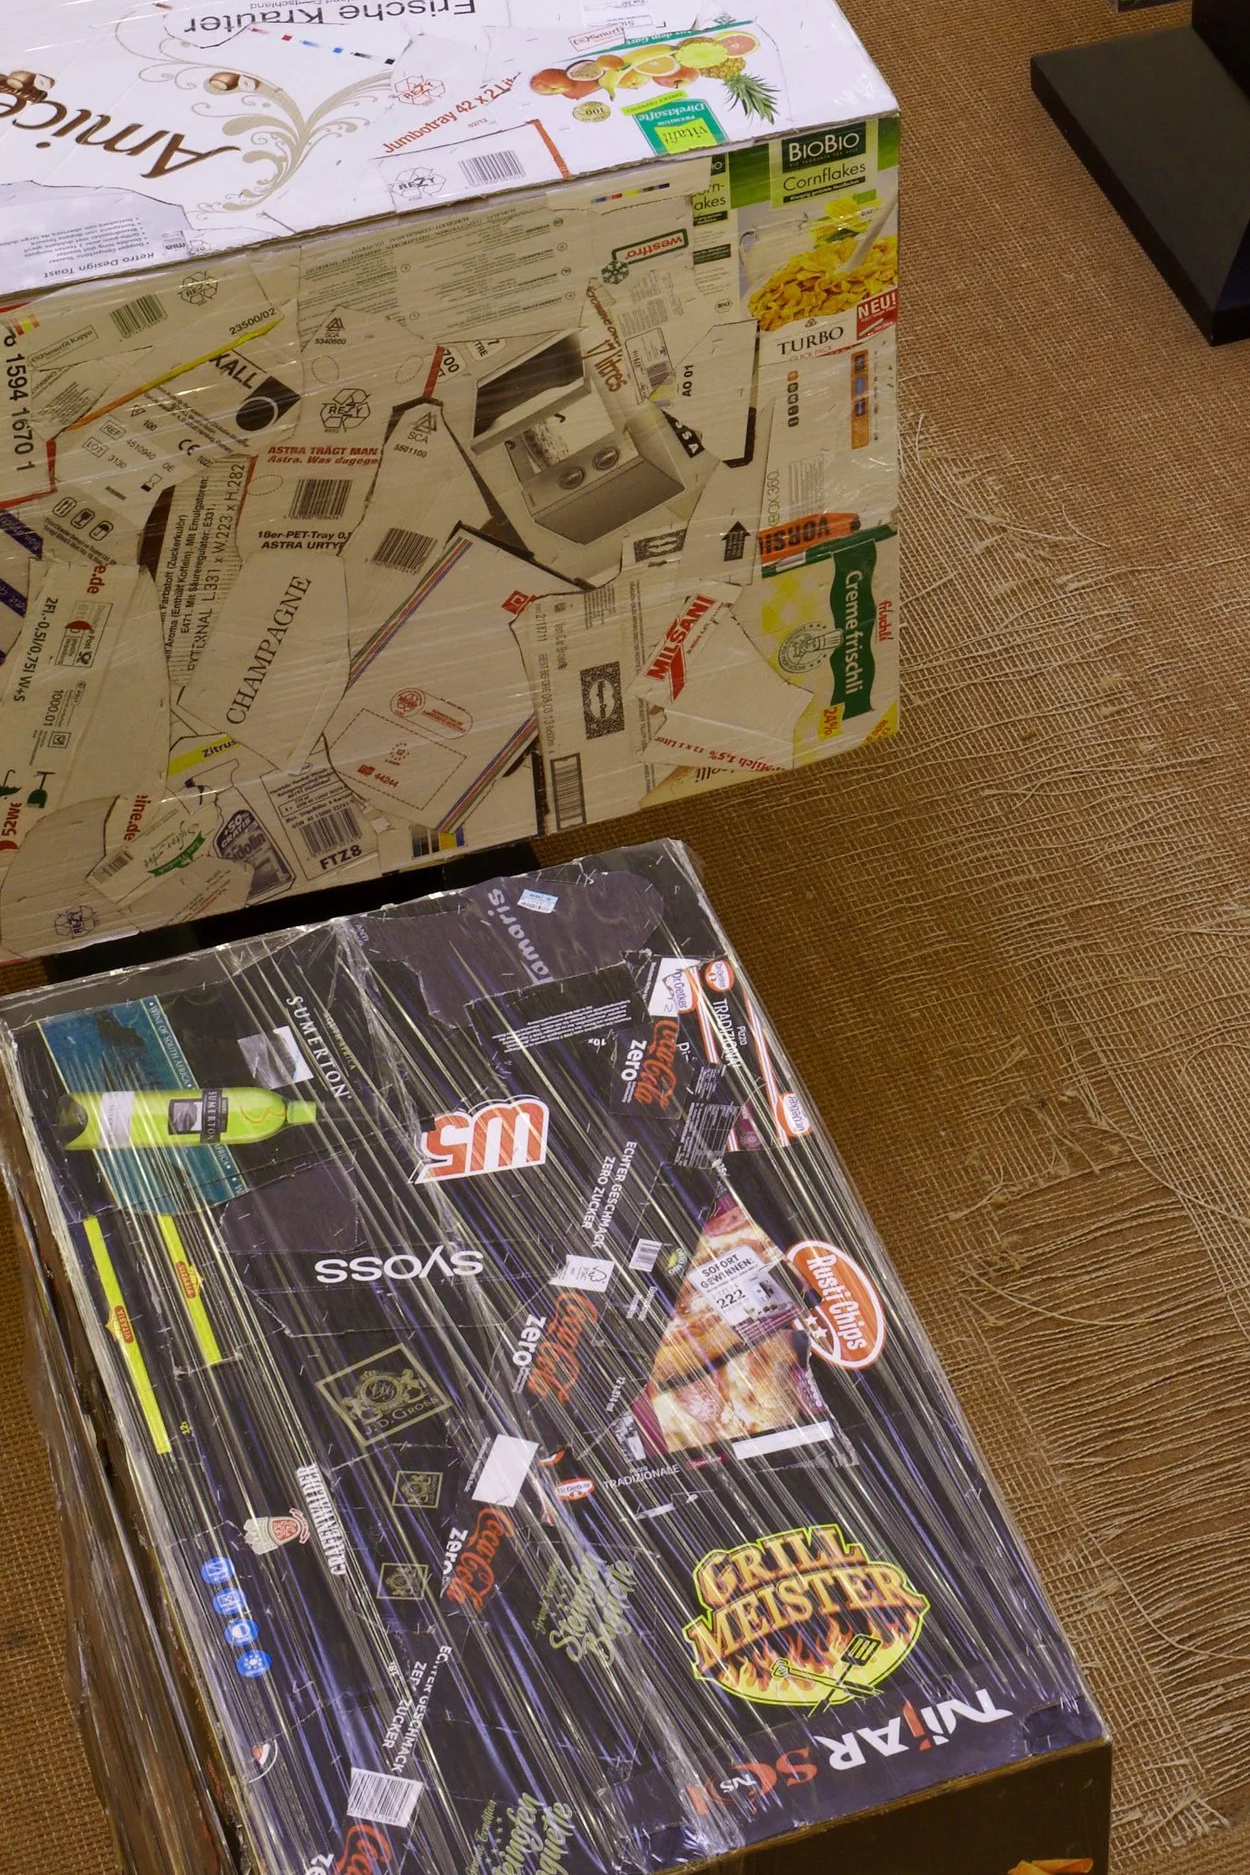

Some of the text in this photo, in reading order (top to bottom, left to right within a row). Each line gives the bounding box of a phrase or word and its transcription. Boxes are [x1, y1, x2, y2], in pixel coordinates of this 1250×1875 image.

[381, 105, 458, 159] Jumbotray
[783, 162, 866, 191] Cornflakes
[79, 251, 155, 272] Retro Design
[625, 233, 684, 260] westfro
[229, 307, 277, 335] 23500/02
[858, 292, 897, 320] NEU!
[777, 326, 844, 356] TURBO
[6, 352, 34, 456] 1594 1670
[328, 404, 363, 417] REZY
[125, 438, 156, 461] 4510940
[267, 445, 378, 456] ASTRA TRÄGT MAN
[393, 444, 428, 458] 5501100
[406, 431, 429, 444] SCA
[107, 452, 129, 470] 3130
[307, 456, 333, 464] Was
[202, 462, 245, 603] L.331 W.223 H.282
[257, 530, 335, 540] 18er-PET-Tray
[261, 541, 304, 550] ASTRA
[165, 475, 209, 648] Aroma Emulgatoren:
[181, 503, 216, 634] E471. Mit Säureregulator: E331.
[159, 571, 174, 610] Farbstoff
[846, 570, 863, 694] Creme frischli
[878, 600, 893, 642] frischli
[226, 575, 312, 726] CHAMPAGNE
[647, 595, 716, 682] MILSANI
[824, 707, 839, 737] 24%
[201, 738, 239, 759] Zitrus
[372, 772, 400, 789] 44244
[219, 816, 255, 849] GRATIS
[318, 844, 364, 873] FTZ8
[488, 888, 554, 986] Tamaris
[286, 995, 353, 1100] SUMERTON
[737, 1025, 747, 1045] Pizza
[621, 1039, 647, 1081] zero
[581, 1154, 616, 1231] ZERO ZUCKER
[590, 1139, 639, 1251] ECHTER GESCHMACK
[701, 1255, 741, 1279] SOFORT
[823, 1293, 880, 1357] Chips
[505, 1308, 552, 1373] zero
[603, 1463, 682, 1491] TRADIZIONALE
[444, 1526, 469, 1579] zero
[699, 1522, 867, 1608] GRILL
[686, 1561, 927, 1670] MEISTER
